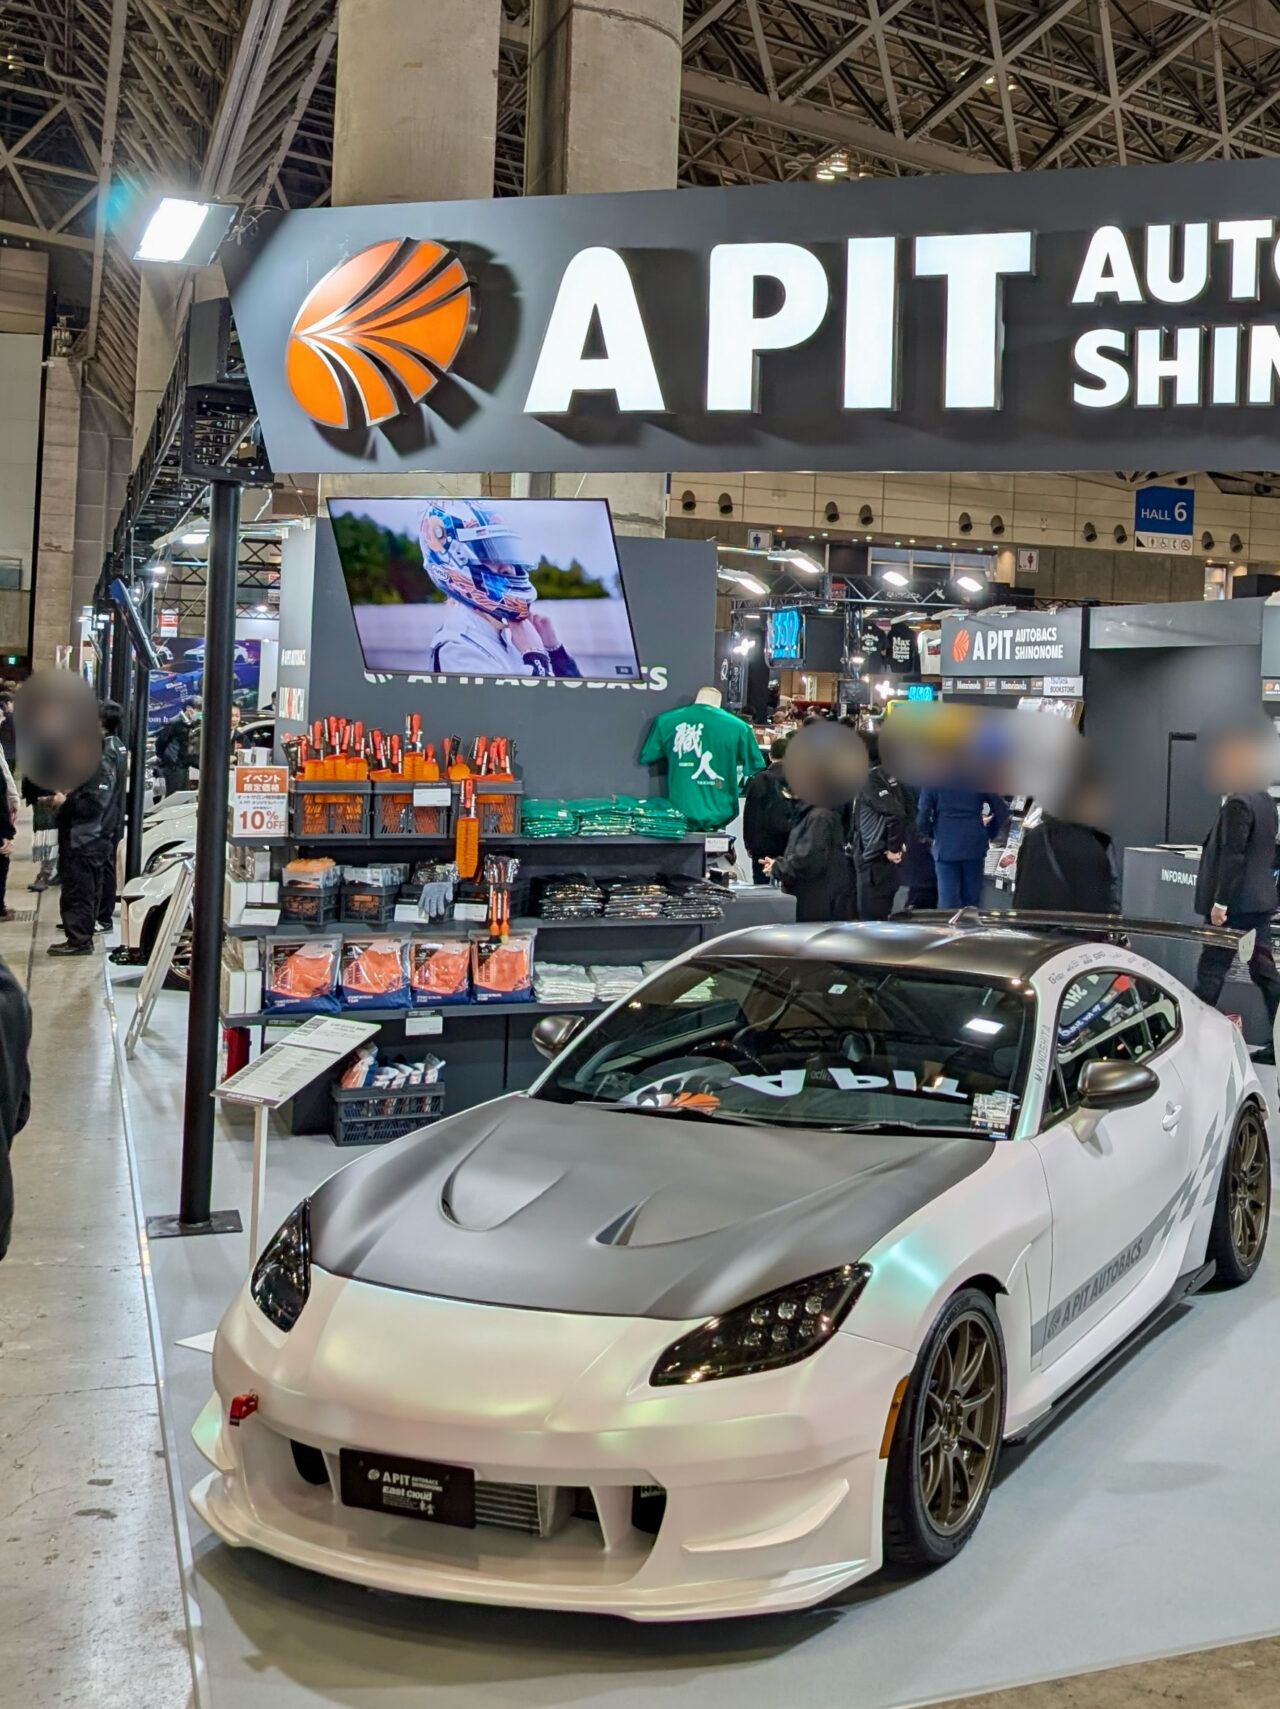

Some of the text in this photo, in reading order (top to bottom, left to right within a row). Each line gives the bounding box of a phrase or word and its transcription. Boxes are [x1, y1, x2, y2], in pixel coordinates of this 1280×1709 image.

[1141, 501, 1188, 522] HALL 6
[1014, 627, 1058, 643] AUTOBACS
[1014, 644, 1064, 660] SHINONOME
[242, 773, 281, 783] イベント
[243, 783, 280, 792] 限定価格
[239, 810, 265, 830] 10
[265, 820, 286, 830] OFF
[1161, 868, 1198, 887] INFORMAT
[1089, 1236, 1144, 1303] AUTOBACS
